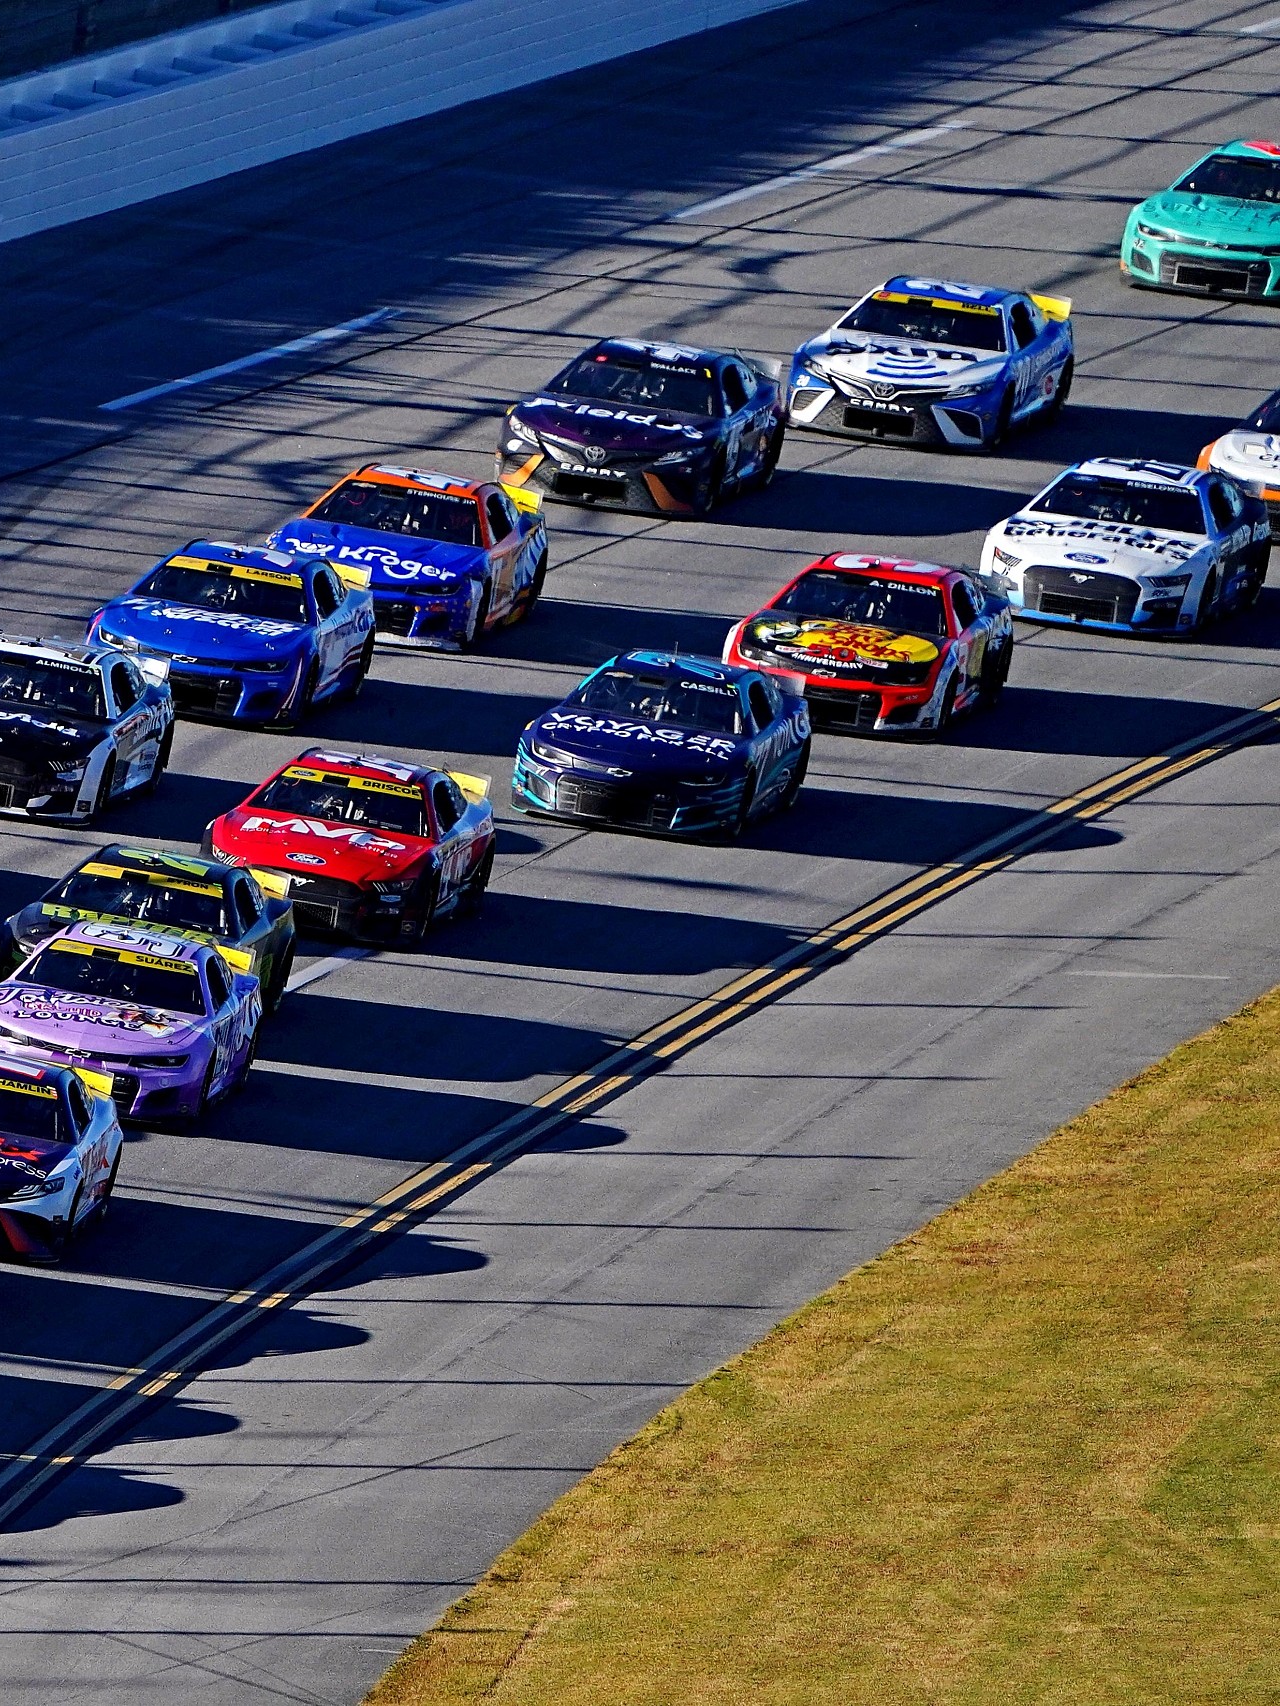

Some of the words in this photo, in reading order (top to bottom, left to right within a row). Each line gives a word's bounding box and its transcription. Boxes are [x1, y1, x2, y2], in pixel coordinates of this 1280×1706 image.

[650, 362, 697, 375] WALLACE
[850, 398, 915, 414] CAMRY
[560, 462, 627, 478] CAMRY
[338, 545, 457, 580] Kroger
[246, 568, 292, 582] LARSON
[887, 581, 937, 598] DILLON
[35, 659, 94, 675] ALMIROLA
[791, 653, 864, 669] ANNIVERSARY
[680, 681, 735, 697] CASSILL
[550, 713, 736, 753] VOYAGER
[541, 722, 632, 738] CRYPTO
[686, 745, 730, 761] ALL
[361, 780, 421, 796] BRISCOE
[242, 816, 407, 851] MVP
[166, 877, 209, 890] BYRON
[135, 955, 193, 973] SUÁREZ
[15, 1011, 142, 1032] LOUNGE
